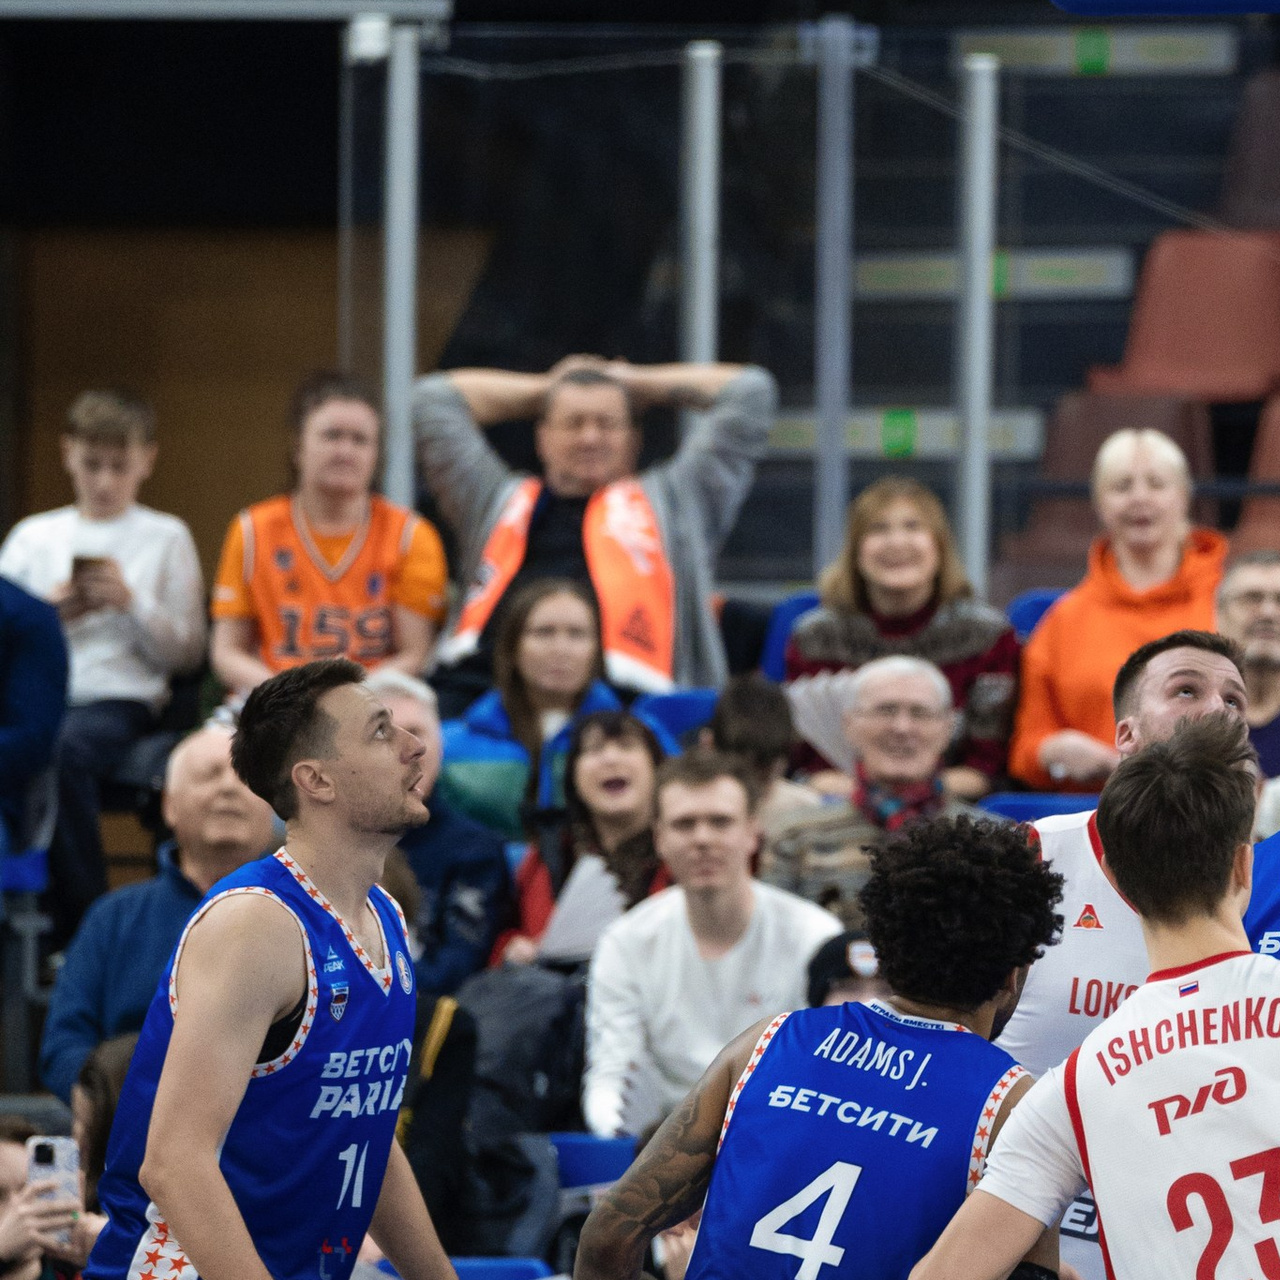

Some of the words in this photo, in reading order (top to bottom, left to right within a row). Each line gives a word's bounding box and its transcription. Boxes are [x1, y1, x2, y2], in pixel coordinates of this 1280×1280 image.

[813, 1028, 915, 1081] ADAMS
[905, 1052, 932, 1091] J.
[768, 1085, 939, 1149] БЕТСИТИ
